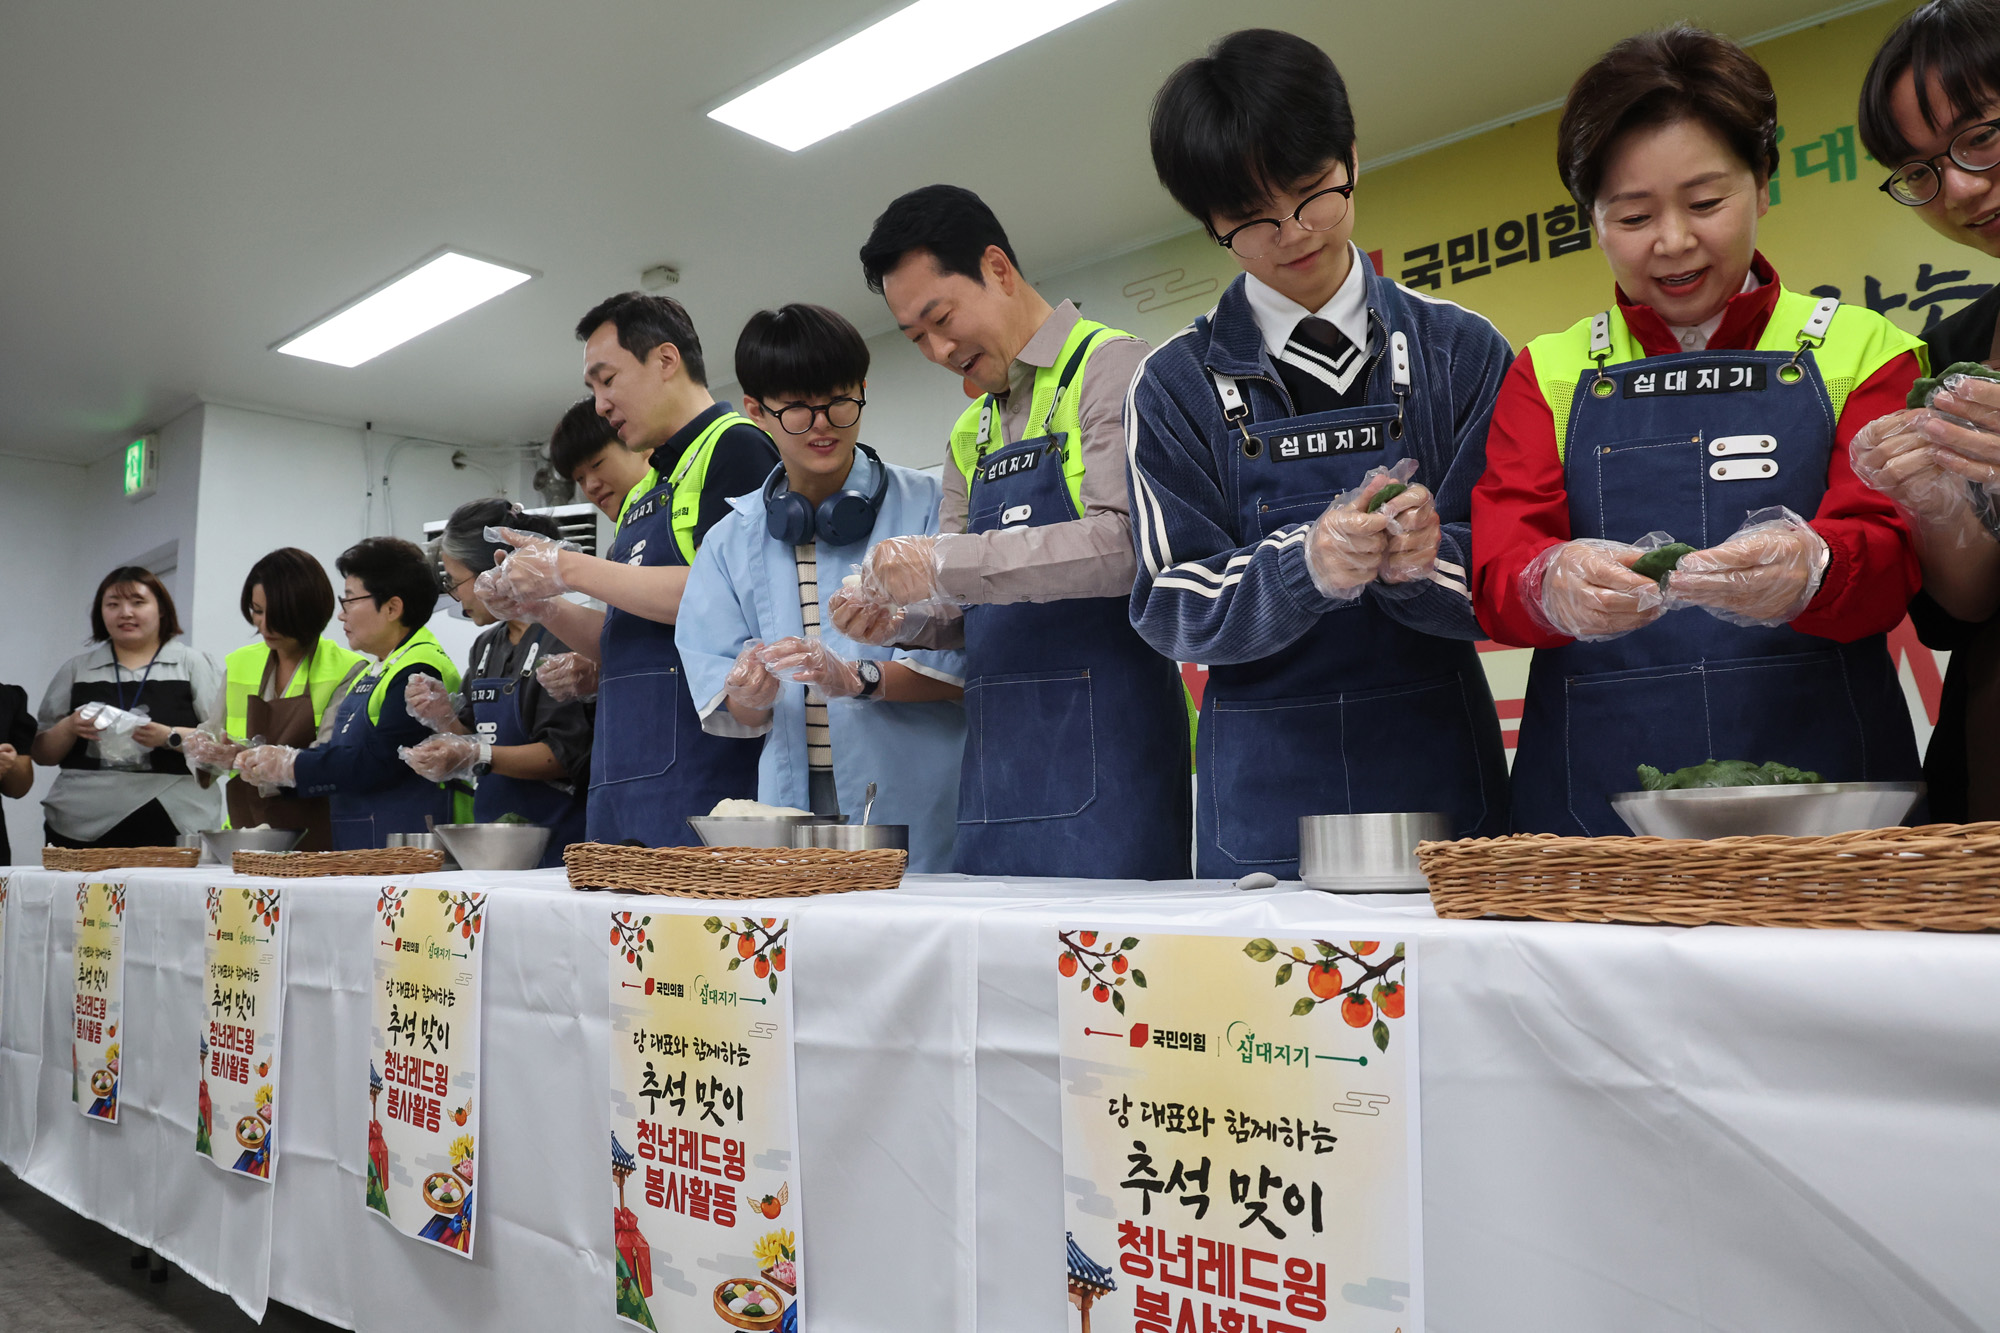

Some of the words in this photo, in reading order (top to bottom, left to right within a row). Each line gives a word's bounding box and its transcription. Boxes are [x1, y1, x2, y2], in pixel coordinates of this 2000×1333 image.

[1634, 367, 1752, 393] 십대지기
[1279, 427, 1377, 457] 십대지기
[988, 452, 1035, 480] 십대지기
[211, 983, 233, 1018] 추석
[235, 989, 255, 1021] 맞이
[386, 978, 395, 998] 당
[396, 981, 420, 1001] 대표와
[656, 981, 684, 997] 국민의힘
[699, 984, 737, 1006] 십대지기
[210, 1021, 254, 1055] 청년레드윙
[386, 1004, 417, 1047] 추석
[421, 1015, 450, 1054] 맞이
[633, 1028, 647, 1054] 당
[650, 1033, 689, 1058] 대표와
[693, 1036, 751, 1066] 함께하는
[1152, 1029, 1206, 1053] 국민의힘
[1236, 1031, 1310, 1069] 십대지기
[211, 1050, 249, 1085] 봉사활동
[384, 1050, 449, 1098] 청년레드윙
[387, 1084, 442, 1134] 봉사활동
[638, 1061, 687, 1117] 추석
[695, 1074, 744, 1127] 맞이
[1108, 1093, 1133, 1128] 당
[1140, 1101, 1216, 1138] 대표와
[1223, 1108, 1338, 1155] 함께하는
[637, 1119, 746, 1183] 청년레드윙
[644, 1164, 738, 1228] 봉사활동
[1119, 1140, 1212, 1220] 추석
[1229, 1164, 1324, 1240] 맞이
[1117, 1219, 1328, 1322] 청년레드윙
[1133, 1284, 1307, 1333] 봉사
